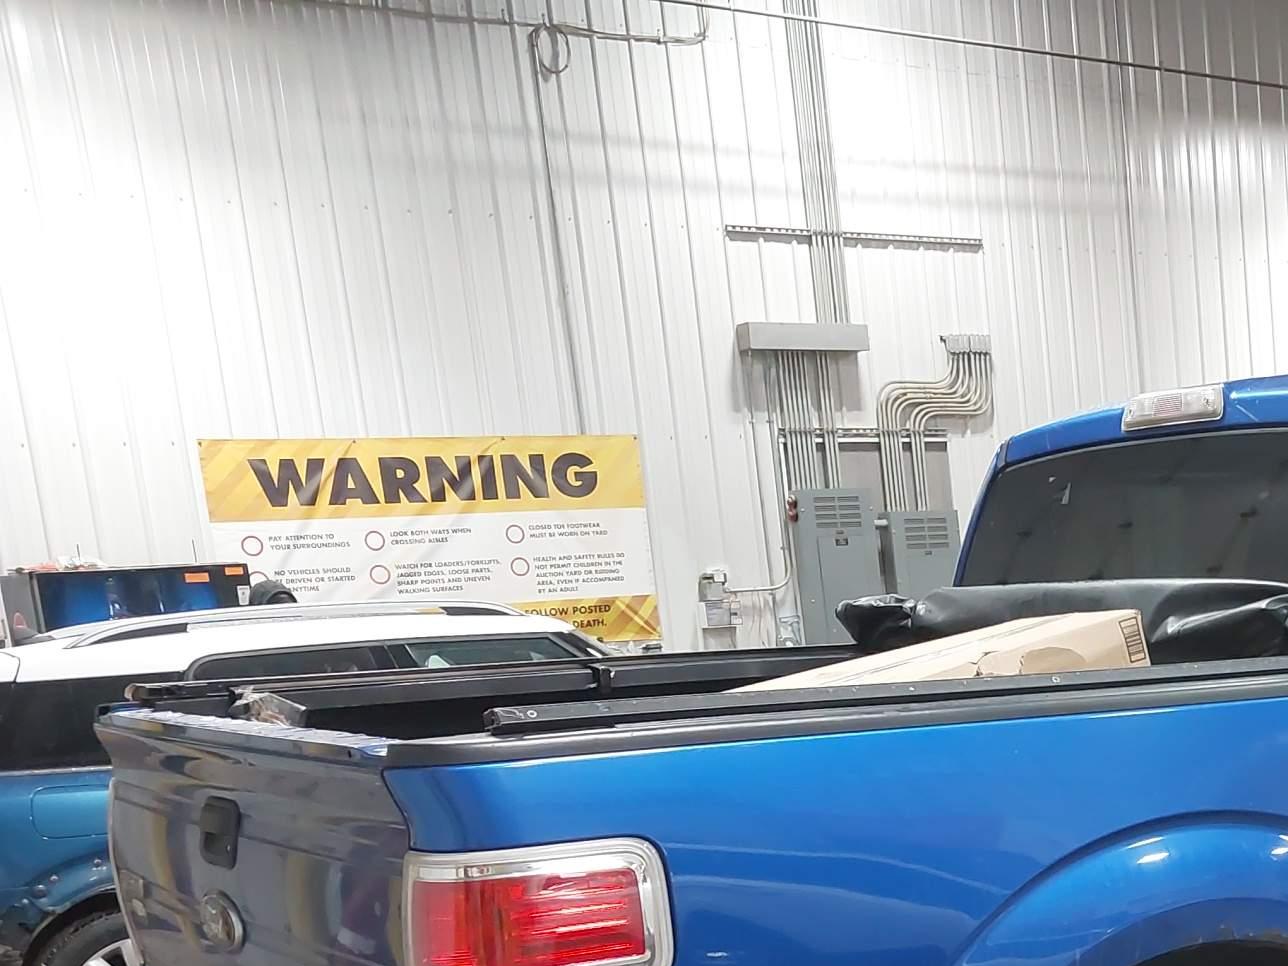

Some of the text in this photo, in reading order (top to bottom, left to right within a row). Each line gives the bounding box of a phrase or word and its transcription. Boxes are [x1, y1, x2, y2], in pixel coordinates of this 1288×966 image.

[247, 452, 598, 507] WARNING
[293, 541, 351, 550] SURROUNDINGS
[397, 587, 430, 595] WALKING
[572, 604, 611, 615] POSTED
[572, 619, 607, 629] DEATH.
